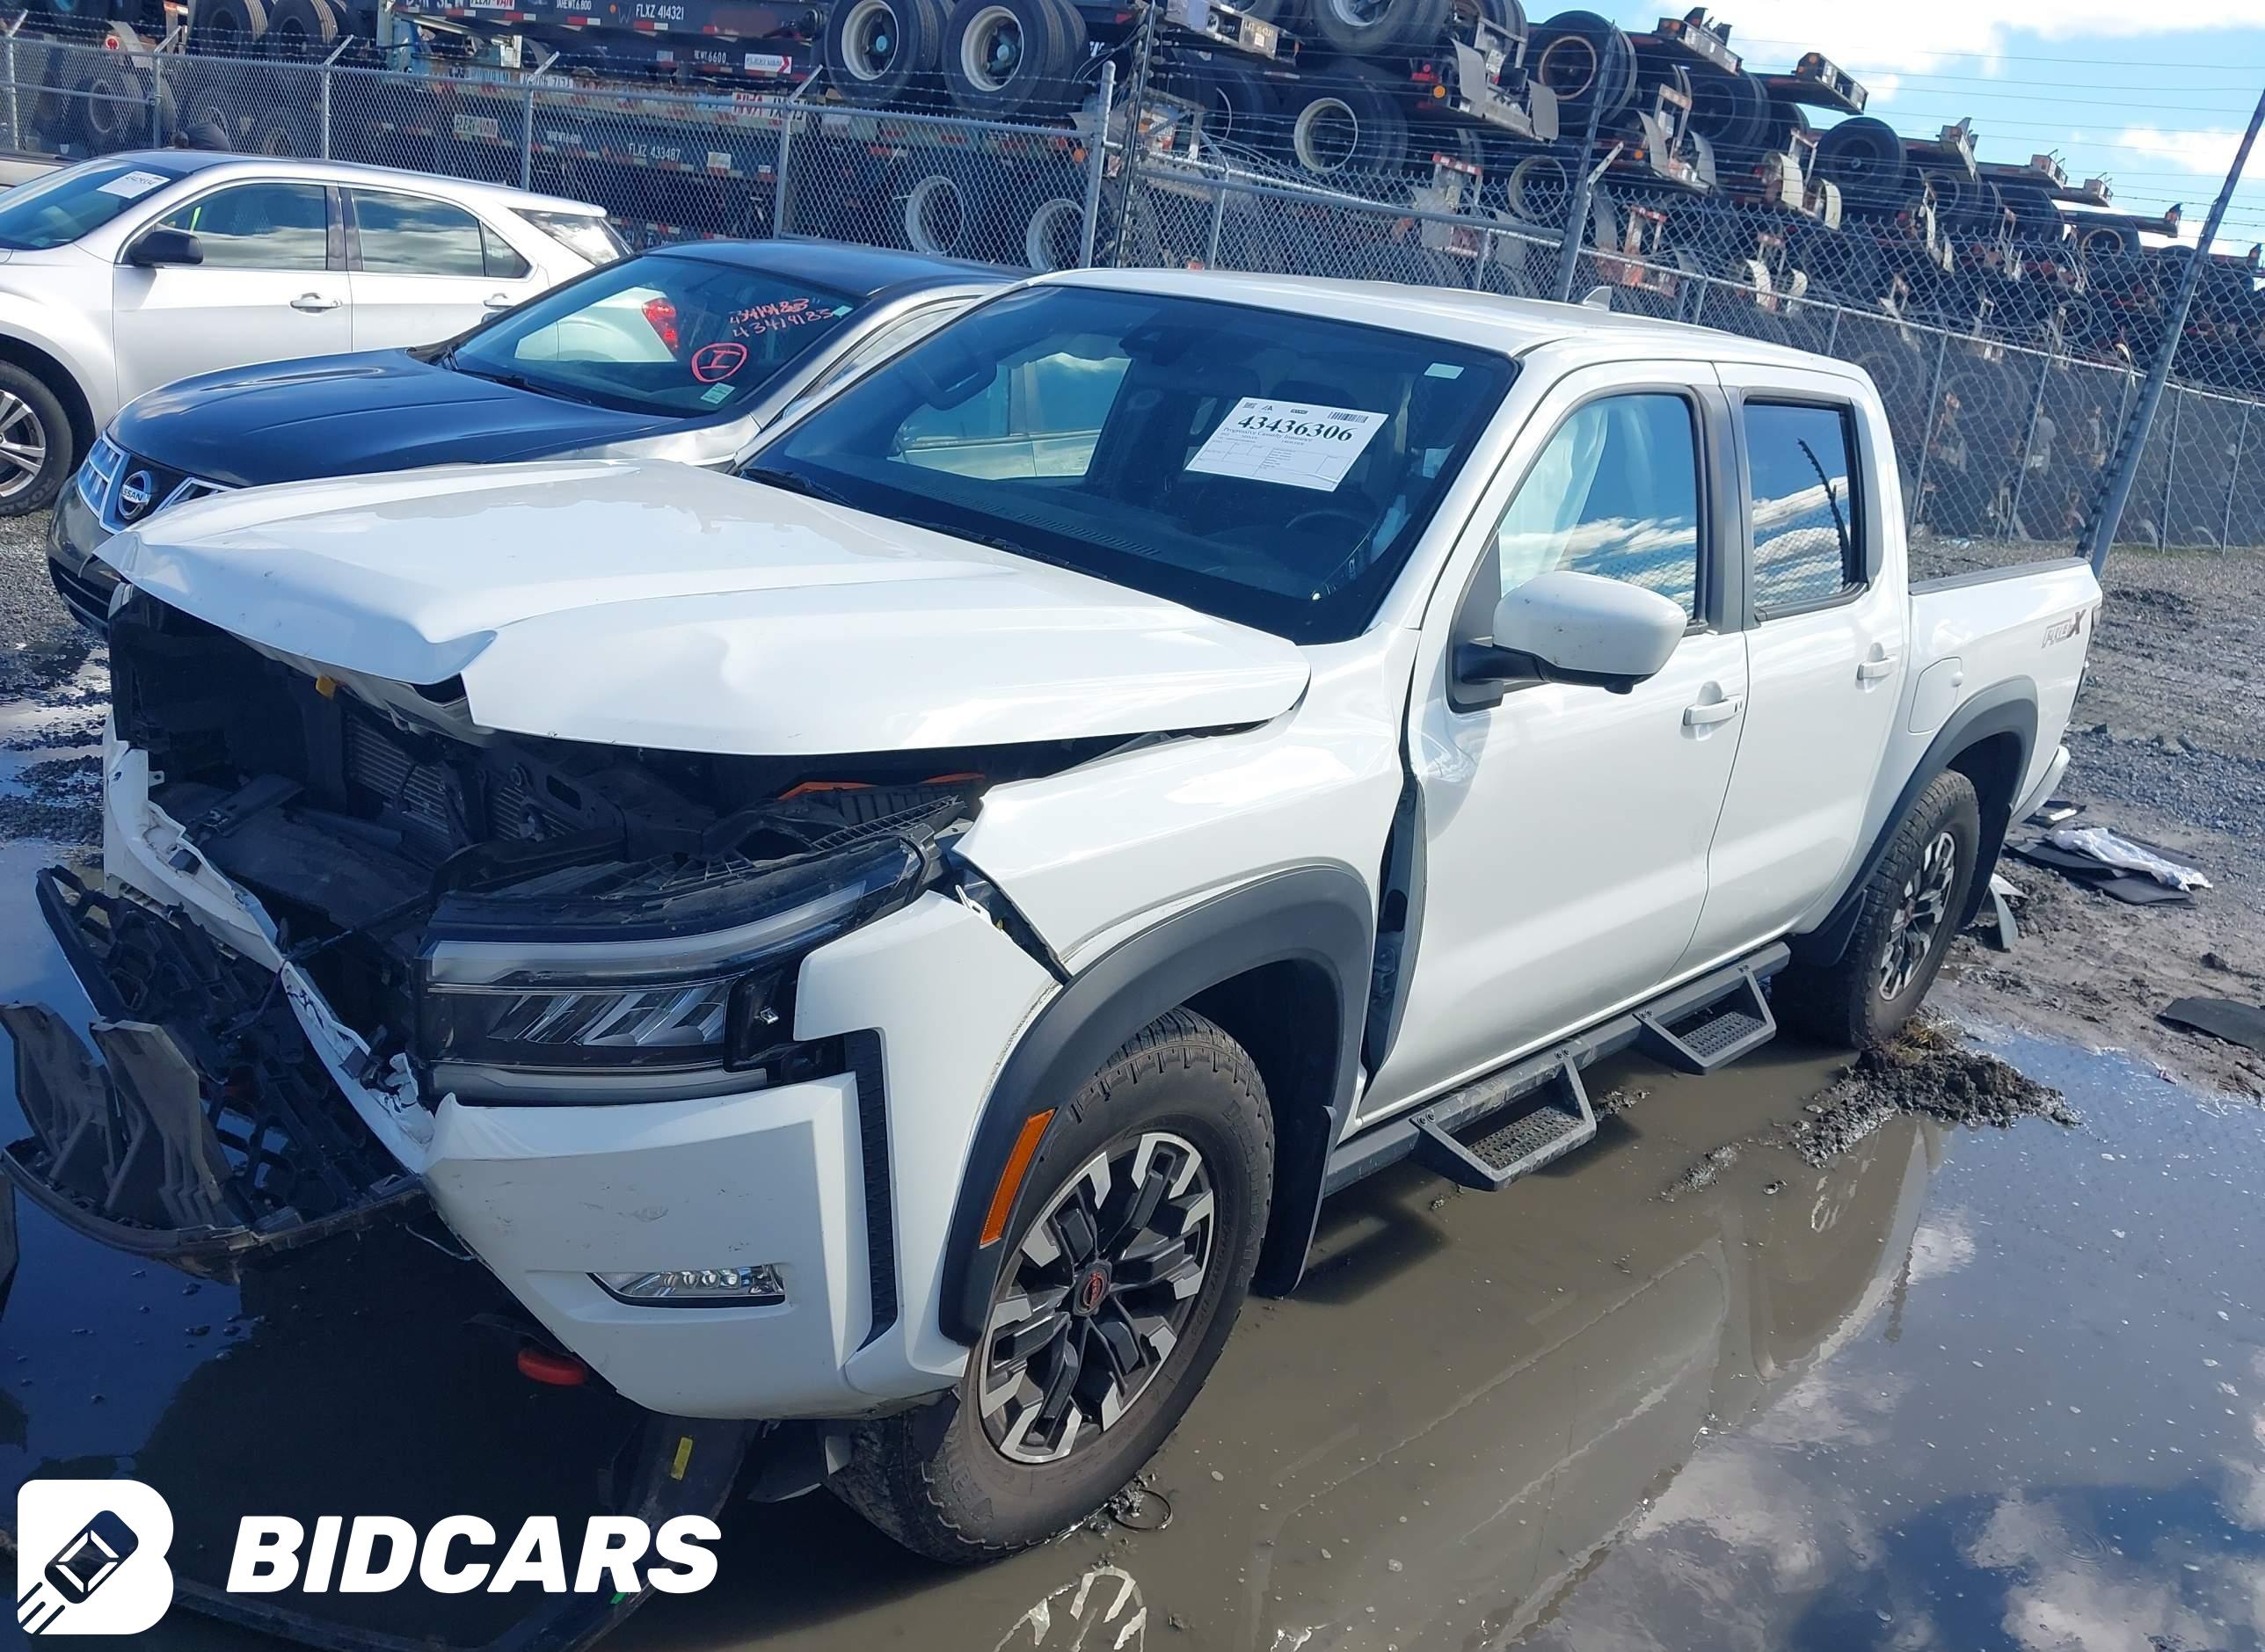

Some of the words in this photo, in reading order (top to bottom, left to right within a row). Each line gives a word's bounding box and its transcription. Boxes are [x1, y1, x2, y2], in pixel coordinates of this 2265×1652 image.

[635, 4, 656, 18] FLXZ
[657, 4, 684, 21] 414321
[628, 142, 648, 158] FLXZ
[650, 145, 681, 163] 433487
[1237, 414, 1358, 442] 43436306
